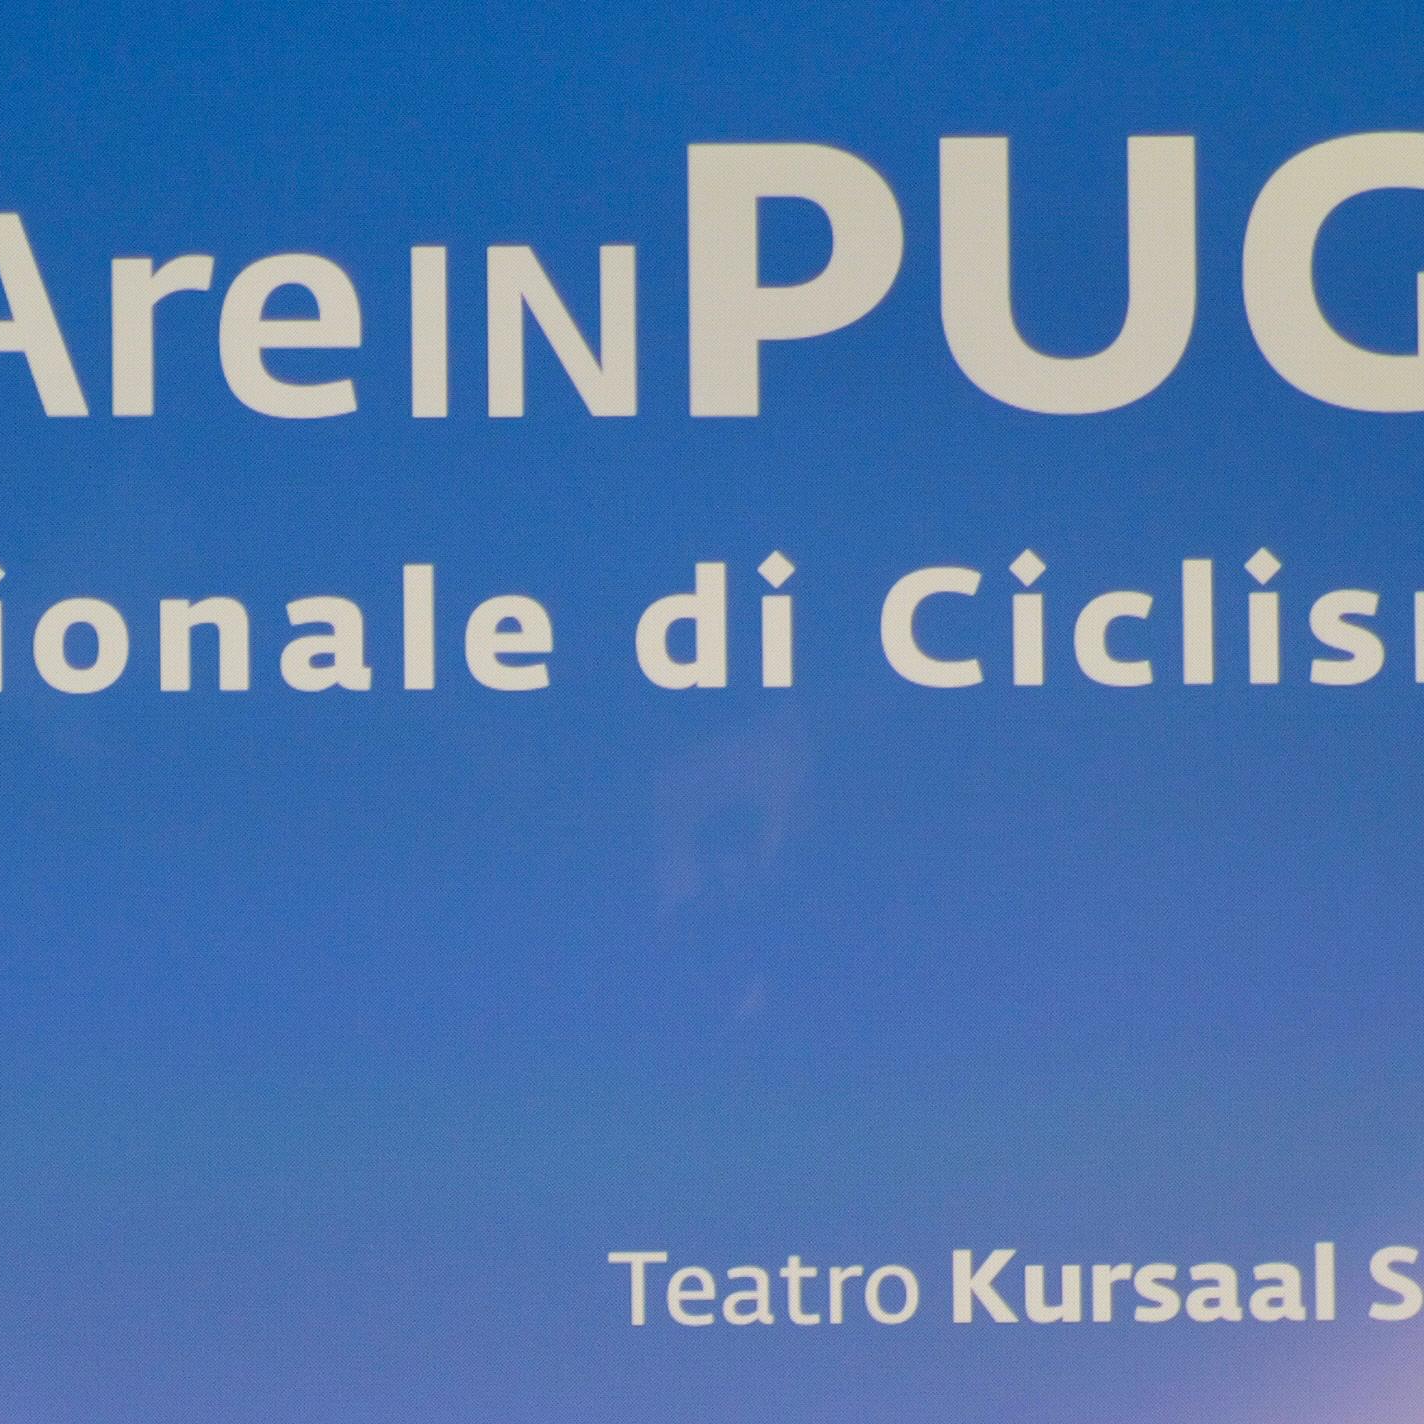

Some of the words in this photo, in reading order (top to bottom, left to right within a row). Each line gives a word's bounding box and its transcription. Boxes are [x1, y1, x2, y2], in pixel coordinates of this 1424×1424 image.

[634, 550, 797, 691] di
[606, 1249, 921, 1328] Teatro
[951, 1240, 1336, 1325] Kursaal
